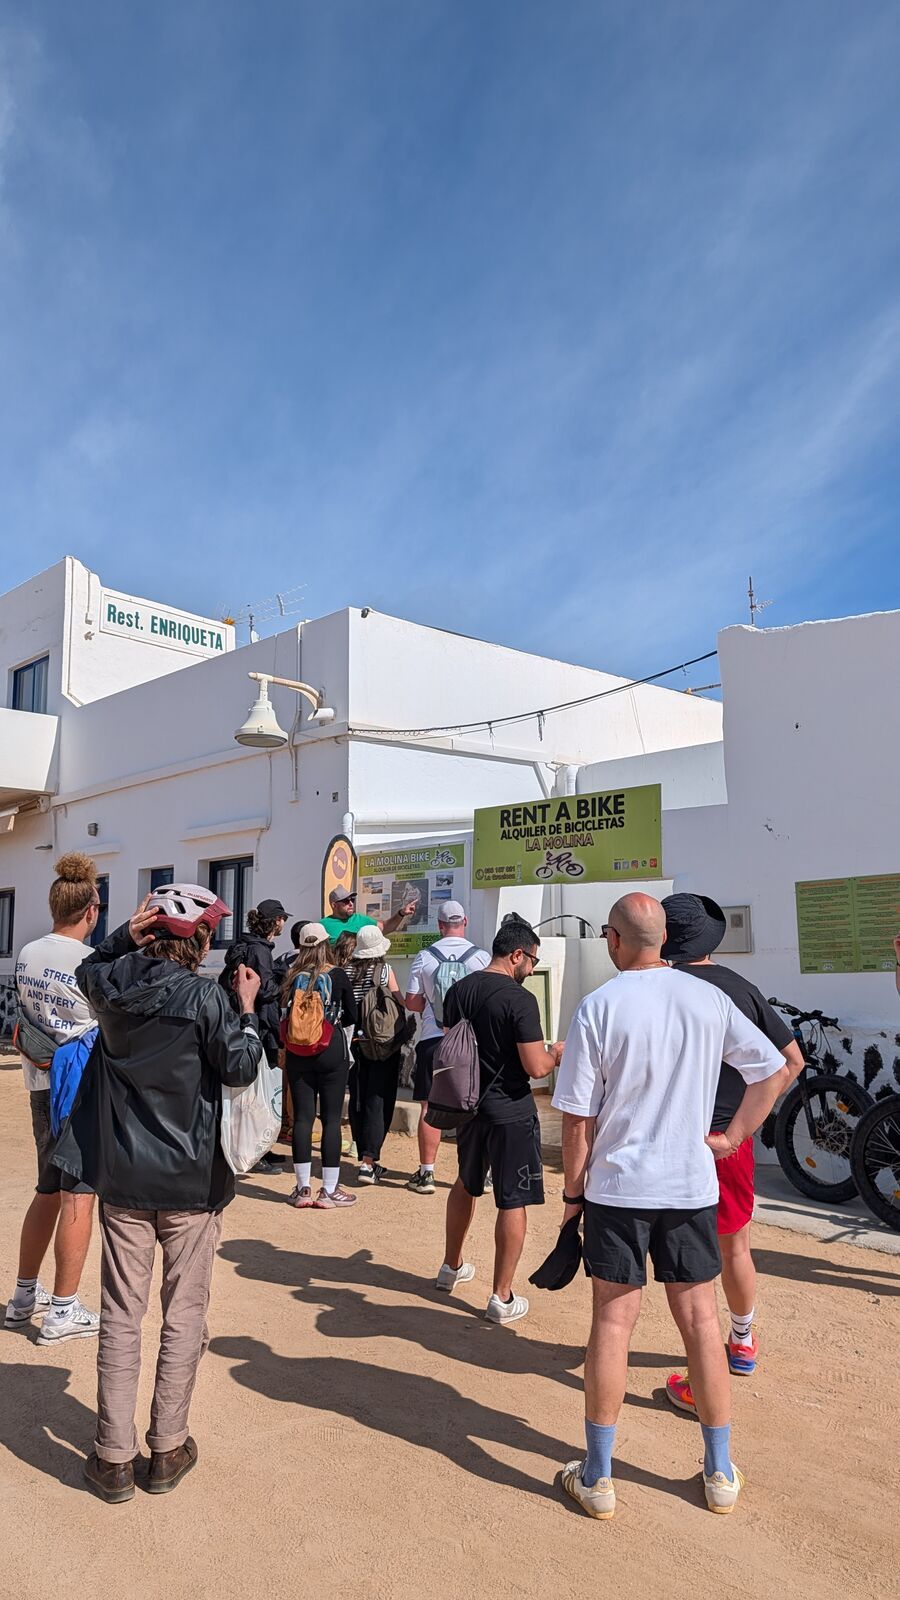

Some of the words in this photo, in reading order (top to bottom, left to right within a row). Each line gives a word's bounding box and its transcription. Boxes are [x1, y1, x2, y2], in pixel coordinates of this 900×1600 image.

[107, 603, 144, 631] Rest.
[150, 615, 223, 651] ENRIQUETA
[500, 803, 551, 828] RENT
[555, 801, 571, 822] A
[576, 793, 625, 820] BIKE
[500, 826, 546, 841] ALQUILER
[550, 823, 562, 835] DE
[564, 816, 625, 833] BICICLETAS
[525, 838, 541, 852] LA
[543, 833, 594, 850] MOLINA
[365, 857, 375, 868] LA
[376, 855, 409, 867] MOLINA
[410, 852, 430, 863] BIKE
[18, 975, 50, 990] RUNWAY
[27, 989, 43, 1001] AND
[44, 994, 77, 1009] EVERY
[33, 1002, 41, 1011] IS
[50, 1007, 58, 1016] A
